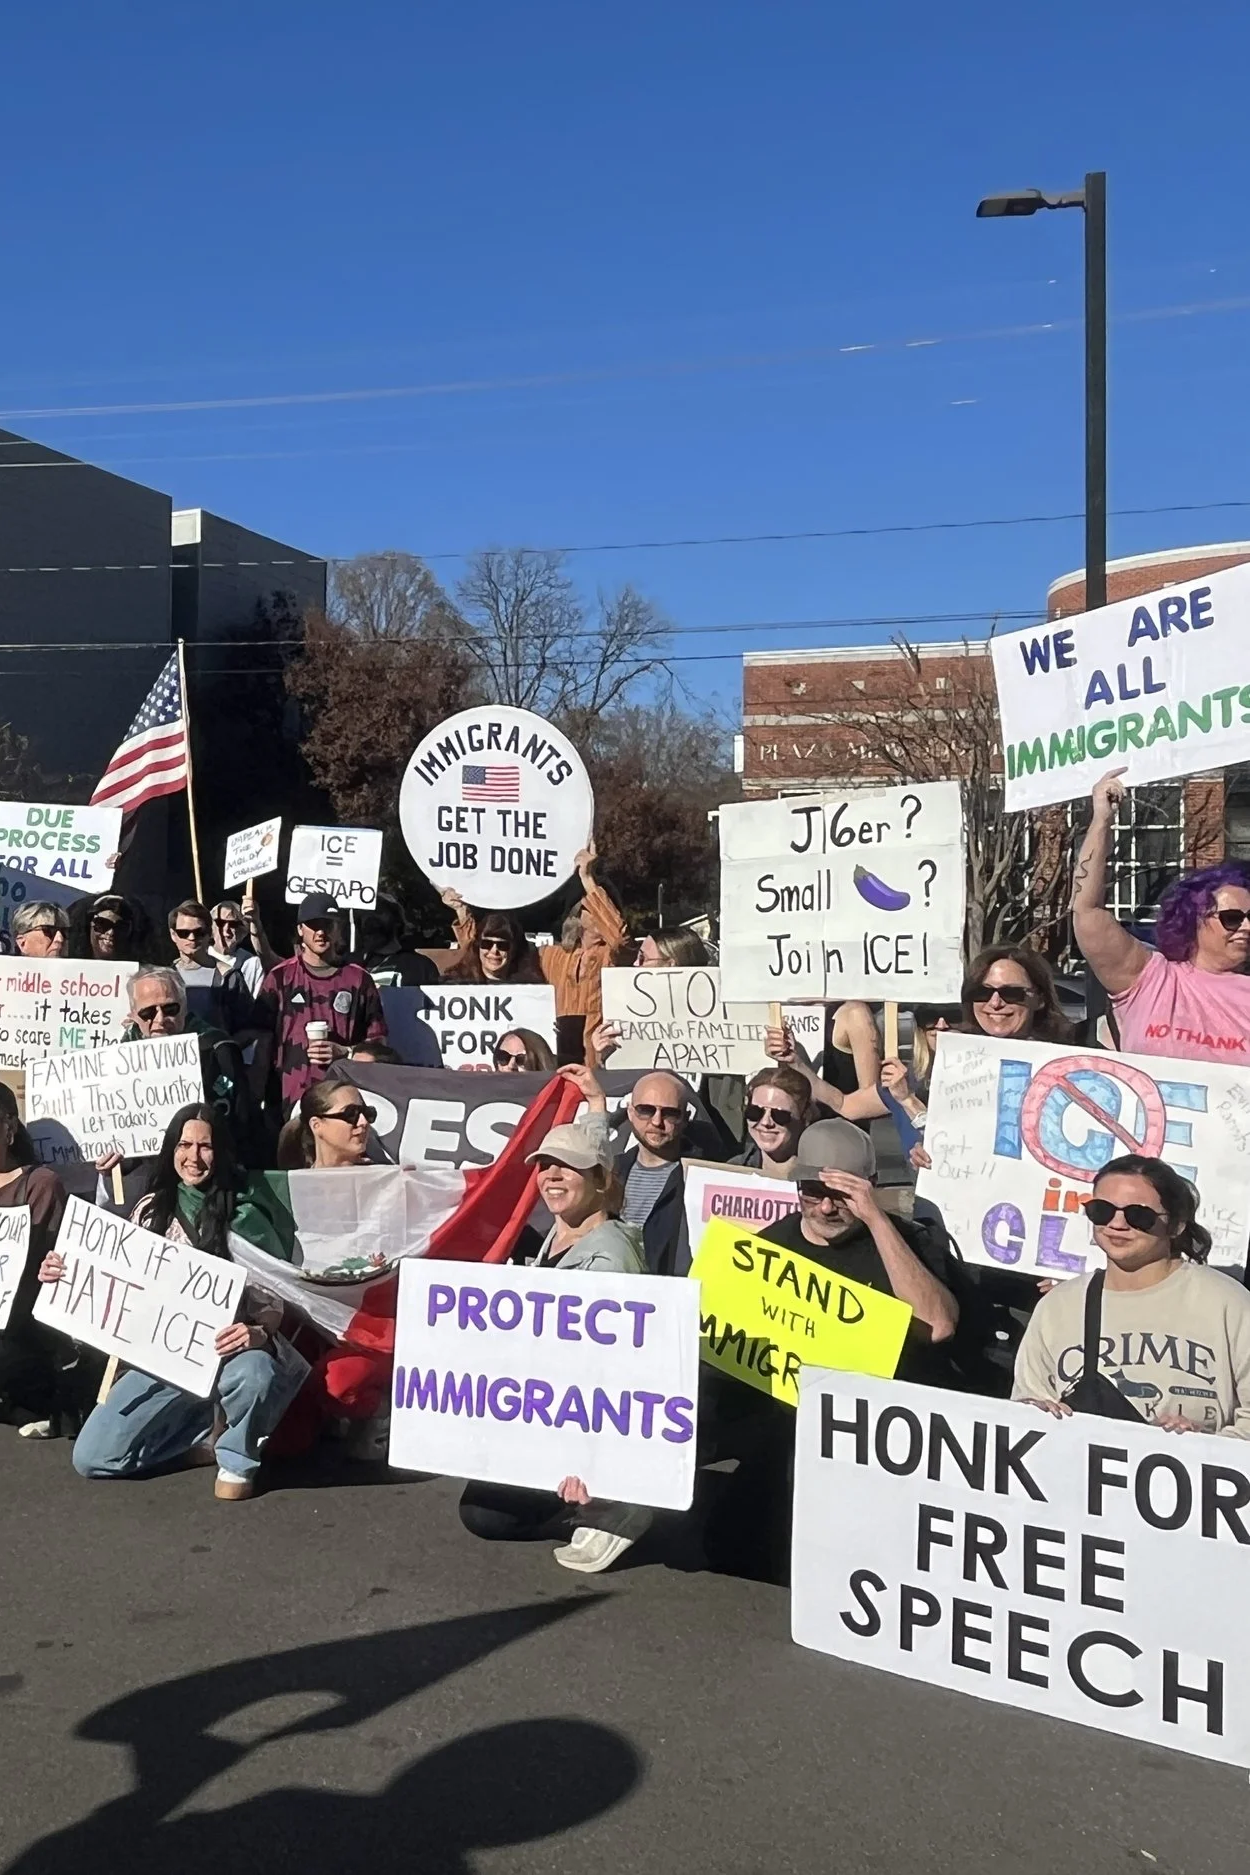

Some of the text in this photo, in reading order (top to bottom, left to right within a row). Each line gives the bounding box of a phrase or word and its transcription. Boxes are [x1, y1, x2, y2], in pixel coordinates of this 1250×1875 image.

[1019, 586, 1215, 676] WE ARE
[1084, 656, 1166, 710] ALL
[414, 722, 573, 786] IMMIGRANTS
[1007, 686, 1250, 780] IMMIGRANTS
[26, 807, 75, 829] DUE
[437, 805, 547, 840] GET THE
[321, 834, 358, 853] ICE
[429, 842, 558, 878] JOB DONE
[50, 857, 93, 879] ALL
[287, 876, 376, 904] GESTAPO
[755, 868, 831, 913] Small
[767, 932, 928, 977] Join ICE!
[6, 971, 52, 995] middle
[59, 972, 120, 999] school
[626, 971, 728, 1020] STO
[59, 1000, 112, 1025] takes
[424, 995, 514, 1022] HONK
[14, 1028, 51, 1046] scare
[59, 1026, 86, 1049] ME
[90, 1029, 120, 1049] th
[441, 1030, 498, 1055] FOR
[1145, 1023, 1171, 1038] NO
[32, 1051, 108, 1088] FAMINE
[654, 1043, 735, 1069] APART
[82, 1084, 127, 1113] This
[711, 1193, 800, 1222] CHARLOTT
[981, 1202, 1096, 1274] CL
[732, 1240, 865, 1324] STAND
[49, 1251, 216, 1367] HATE ICE
[427, 1284, 656, 1348] PROTECT
[762, 1296, 815, 1339] WITH
[700, 1313, 800, 1392] MMIGR
[1057, 1332, 1216, 1385] CRIME
[395, 1366, 695, 1444] IMMIGRANTS
[1145, 1402, 1218, 1421] KIE
[820, 1392, 1250, 1546] HONK FOR
[917, 1503, 1126, 1614] FREE
[839, 1569, 1225, 1737] SPEECH
